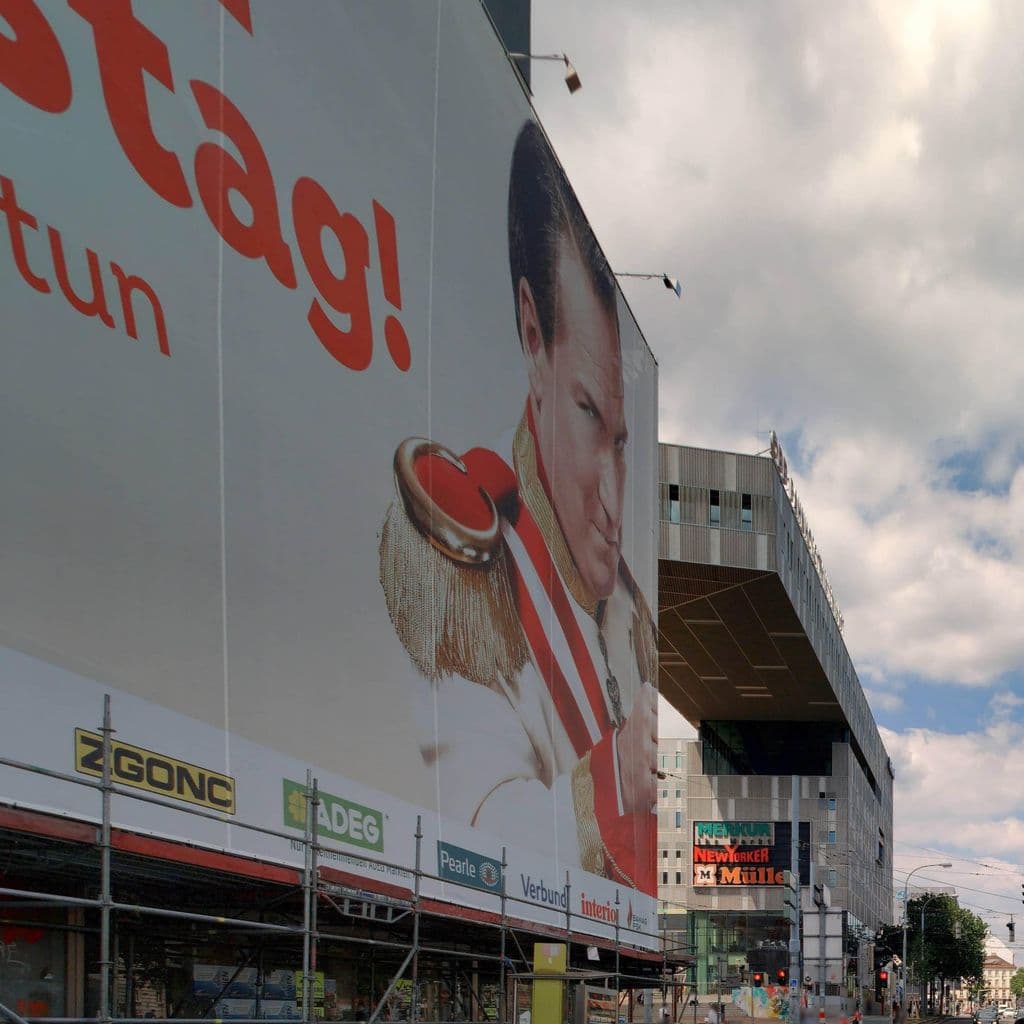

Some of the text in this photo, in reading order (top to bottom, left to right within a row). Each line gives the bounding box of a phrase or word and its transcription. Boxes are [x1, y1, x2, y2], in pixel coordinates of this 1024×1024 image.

[80, 735, 232, 807] ZGONC
[315, 798, 380, 844] ADEG
[440, 853, 476, 879] Pearle
[720, 866, 785, 885] Mülle
[520, 873, 566, 908] Verbund
[580, 892, 618, 923] interio
